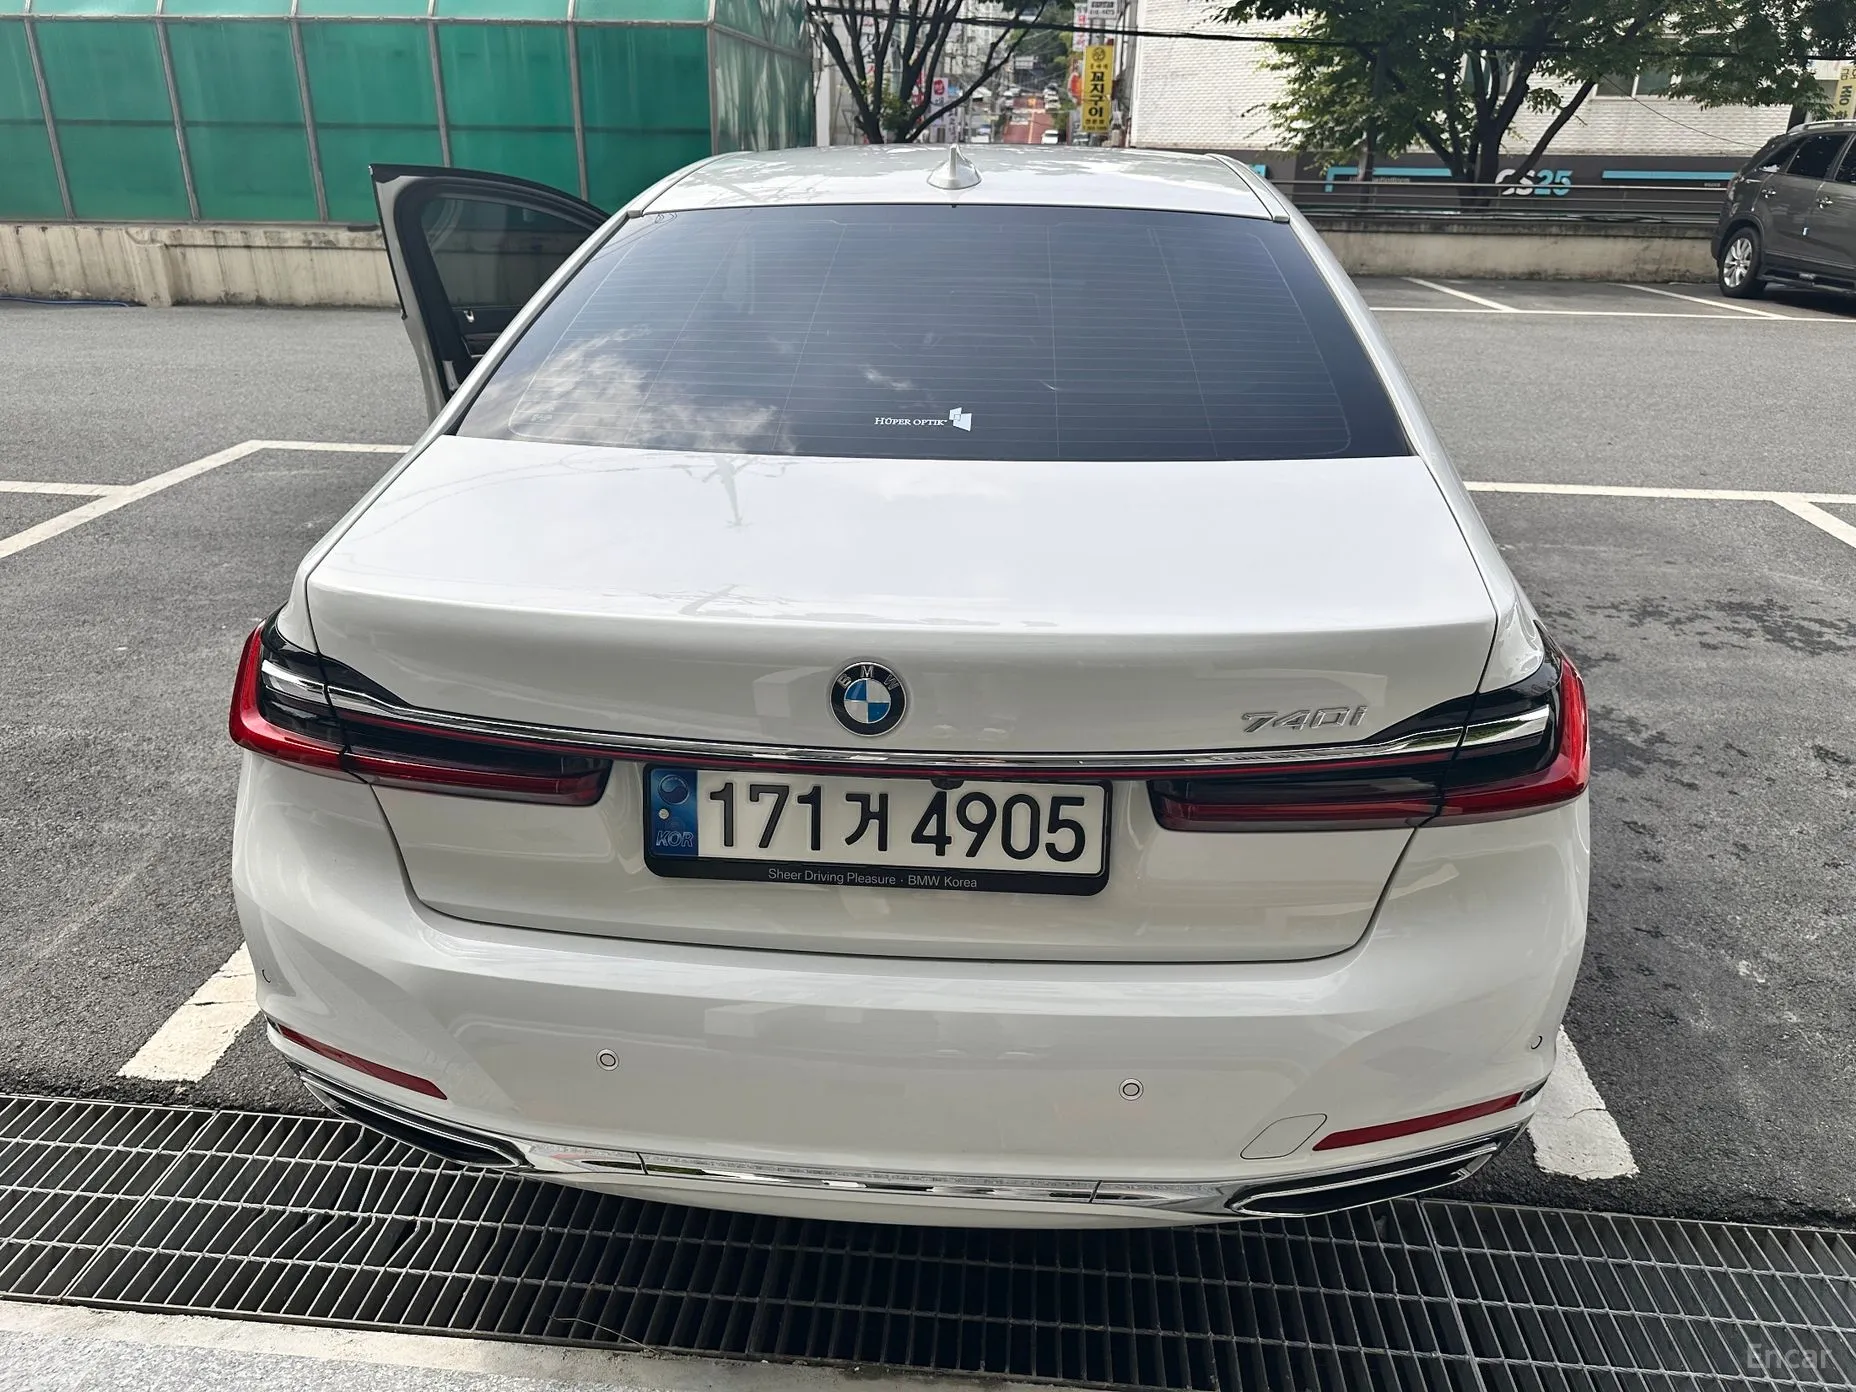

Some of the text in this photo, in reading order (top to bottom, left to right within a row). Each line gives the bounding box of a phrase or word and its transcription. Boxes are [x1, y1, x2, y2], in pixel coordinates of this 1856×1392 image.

[837, 665, 900, 691] BMW
[1241, 705, 1368, 733] 740i
[655, 830, 695, 848] KOR
[910, 790, 1087, 863] 4905
[768, 868, 977, 888] Sheer Driving Pleasure BMW Korea
